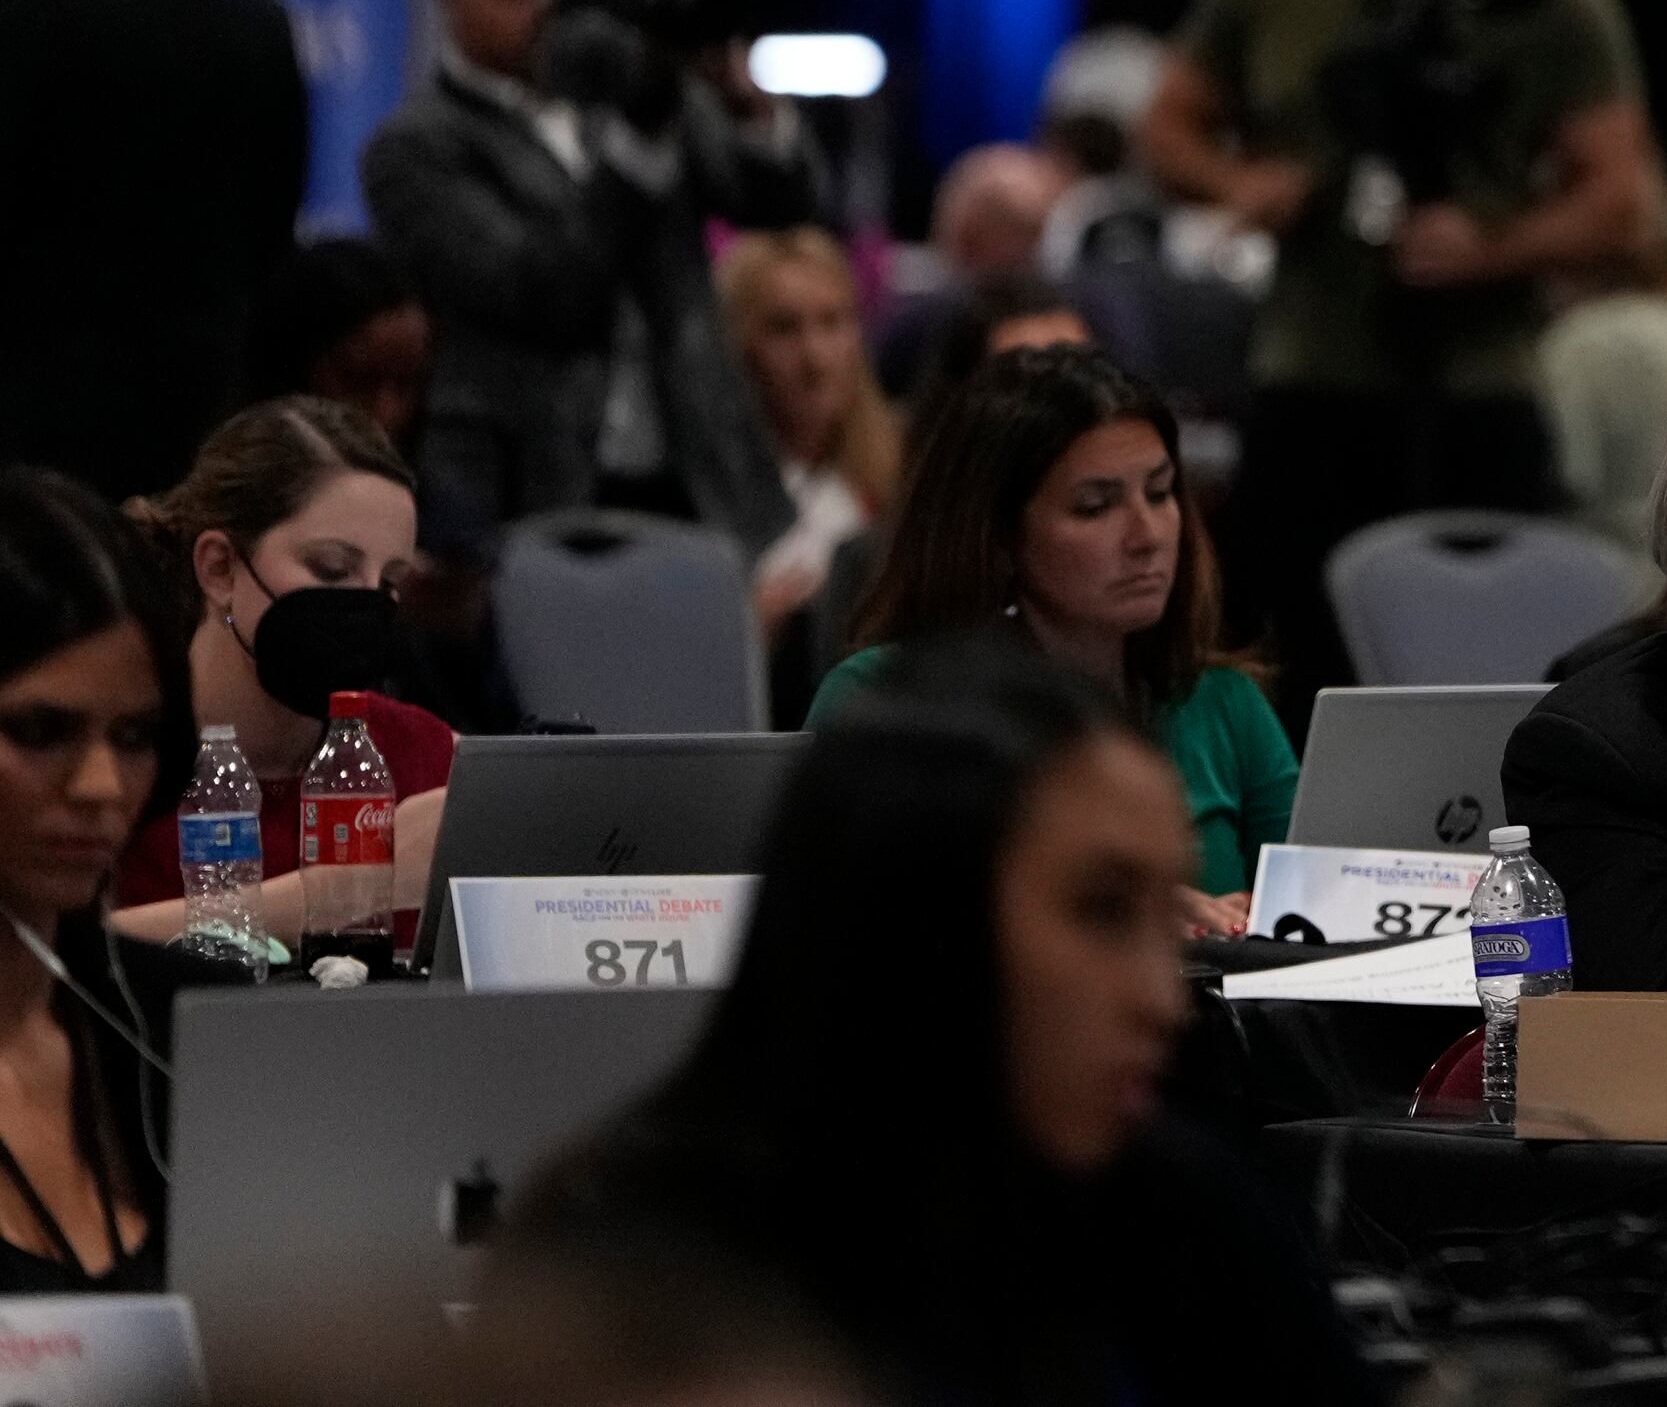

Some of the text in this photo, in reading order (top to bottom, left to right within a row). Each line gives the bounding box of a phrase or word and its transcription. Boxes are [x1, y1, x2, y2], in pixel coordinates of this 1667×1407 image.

[535, 899, 723, 914] PRESIDENTIAL DEBATE
[585, 939, 688, 986] 871
